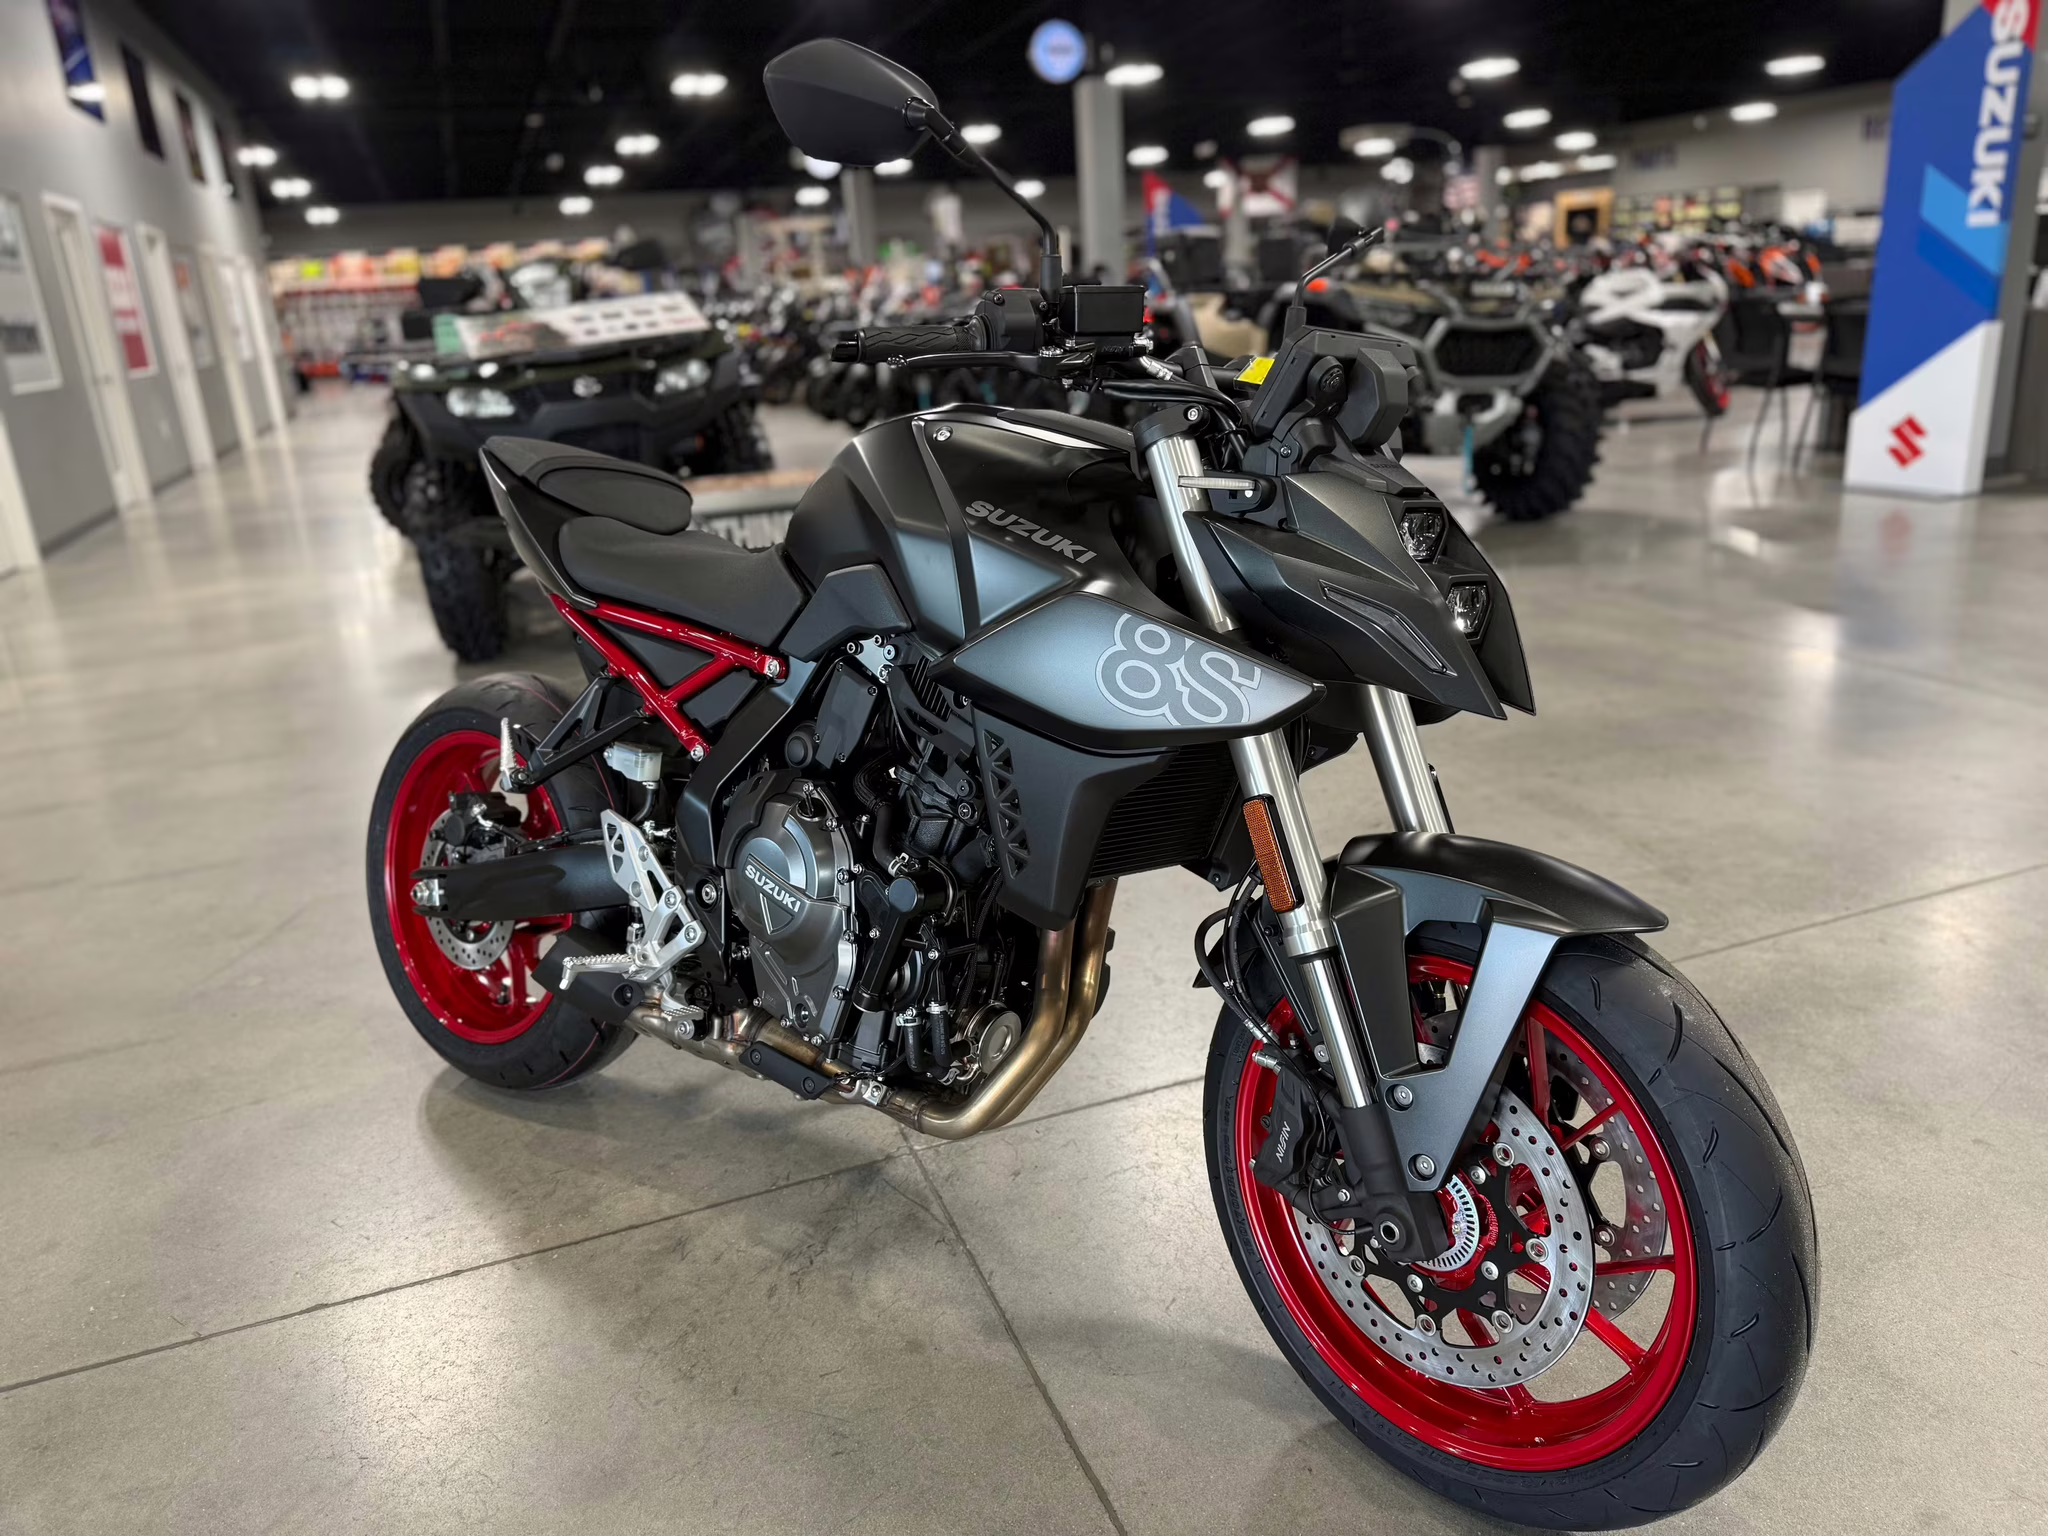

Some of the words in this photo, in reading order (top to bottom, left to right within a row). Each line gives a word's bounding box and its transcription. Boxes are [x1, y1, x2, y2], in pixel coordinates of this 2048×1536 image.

[1965, 0, 2031, 228] SUZUKI
[965, 500, 1097, 564] SUZUKI
[744, 864, 801, 913] SUZUKI
